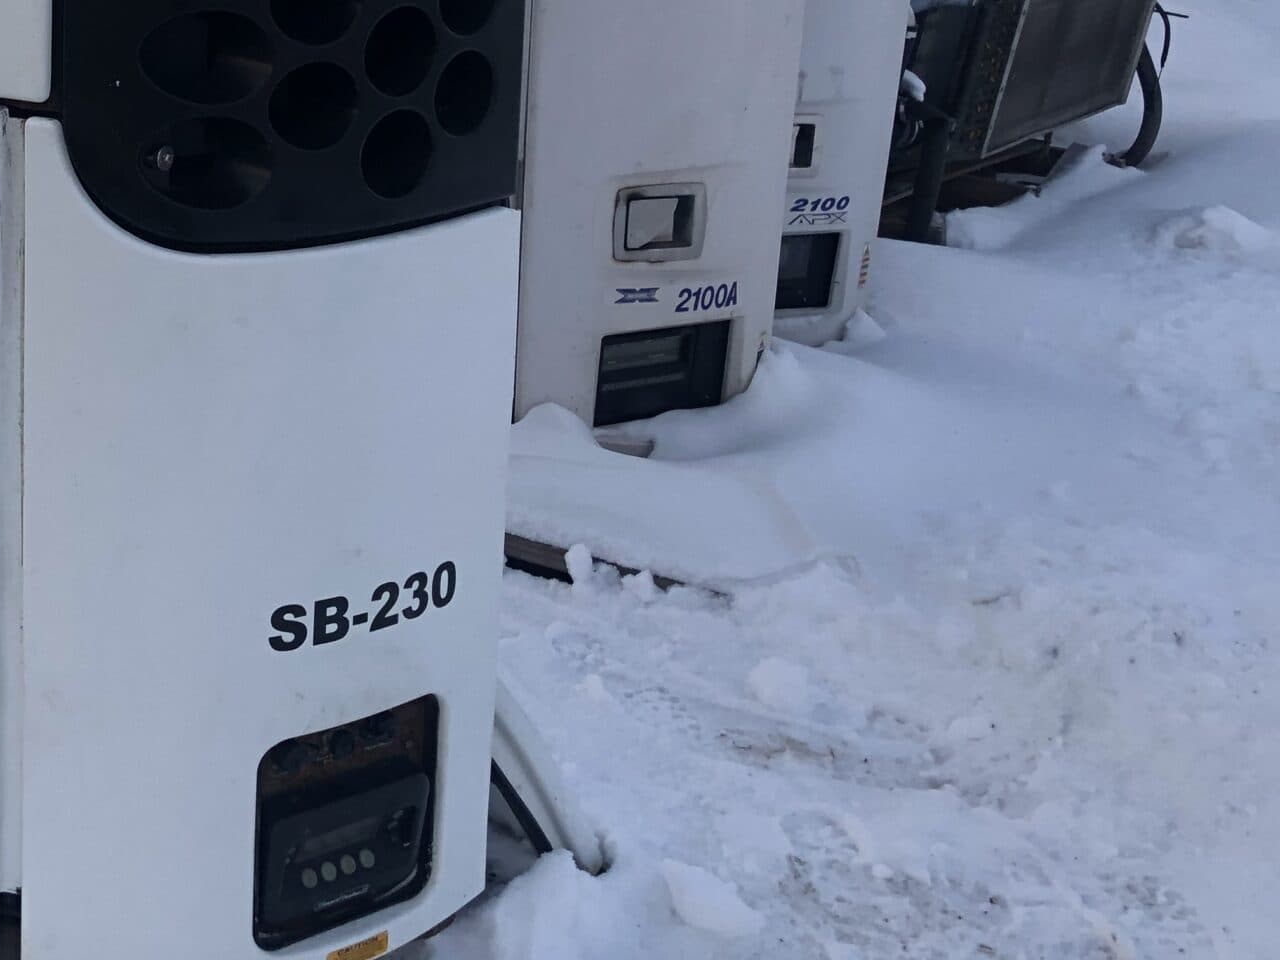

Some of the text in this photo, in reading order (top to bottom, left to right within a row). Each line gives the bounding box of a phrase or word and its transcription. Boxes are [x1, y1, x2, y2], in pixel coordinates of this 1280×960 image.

[789, 196, 850, 212] 2100
[675, 282, 738, 313] 2100A
[268, 561, 457, 652] SB-230
